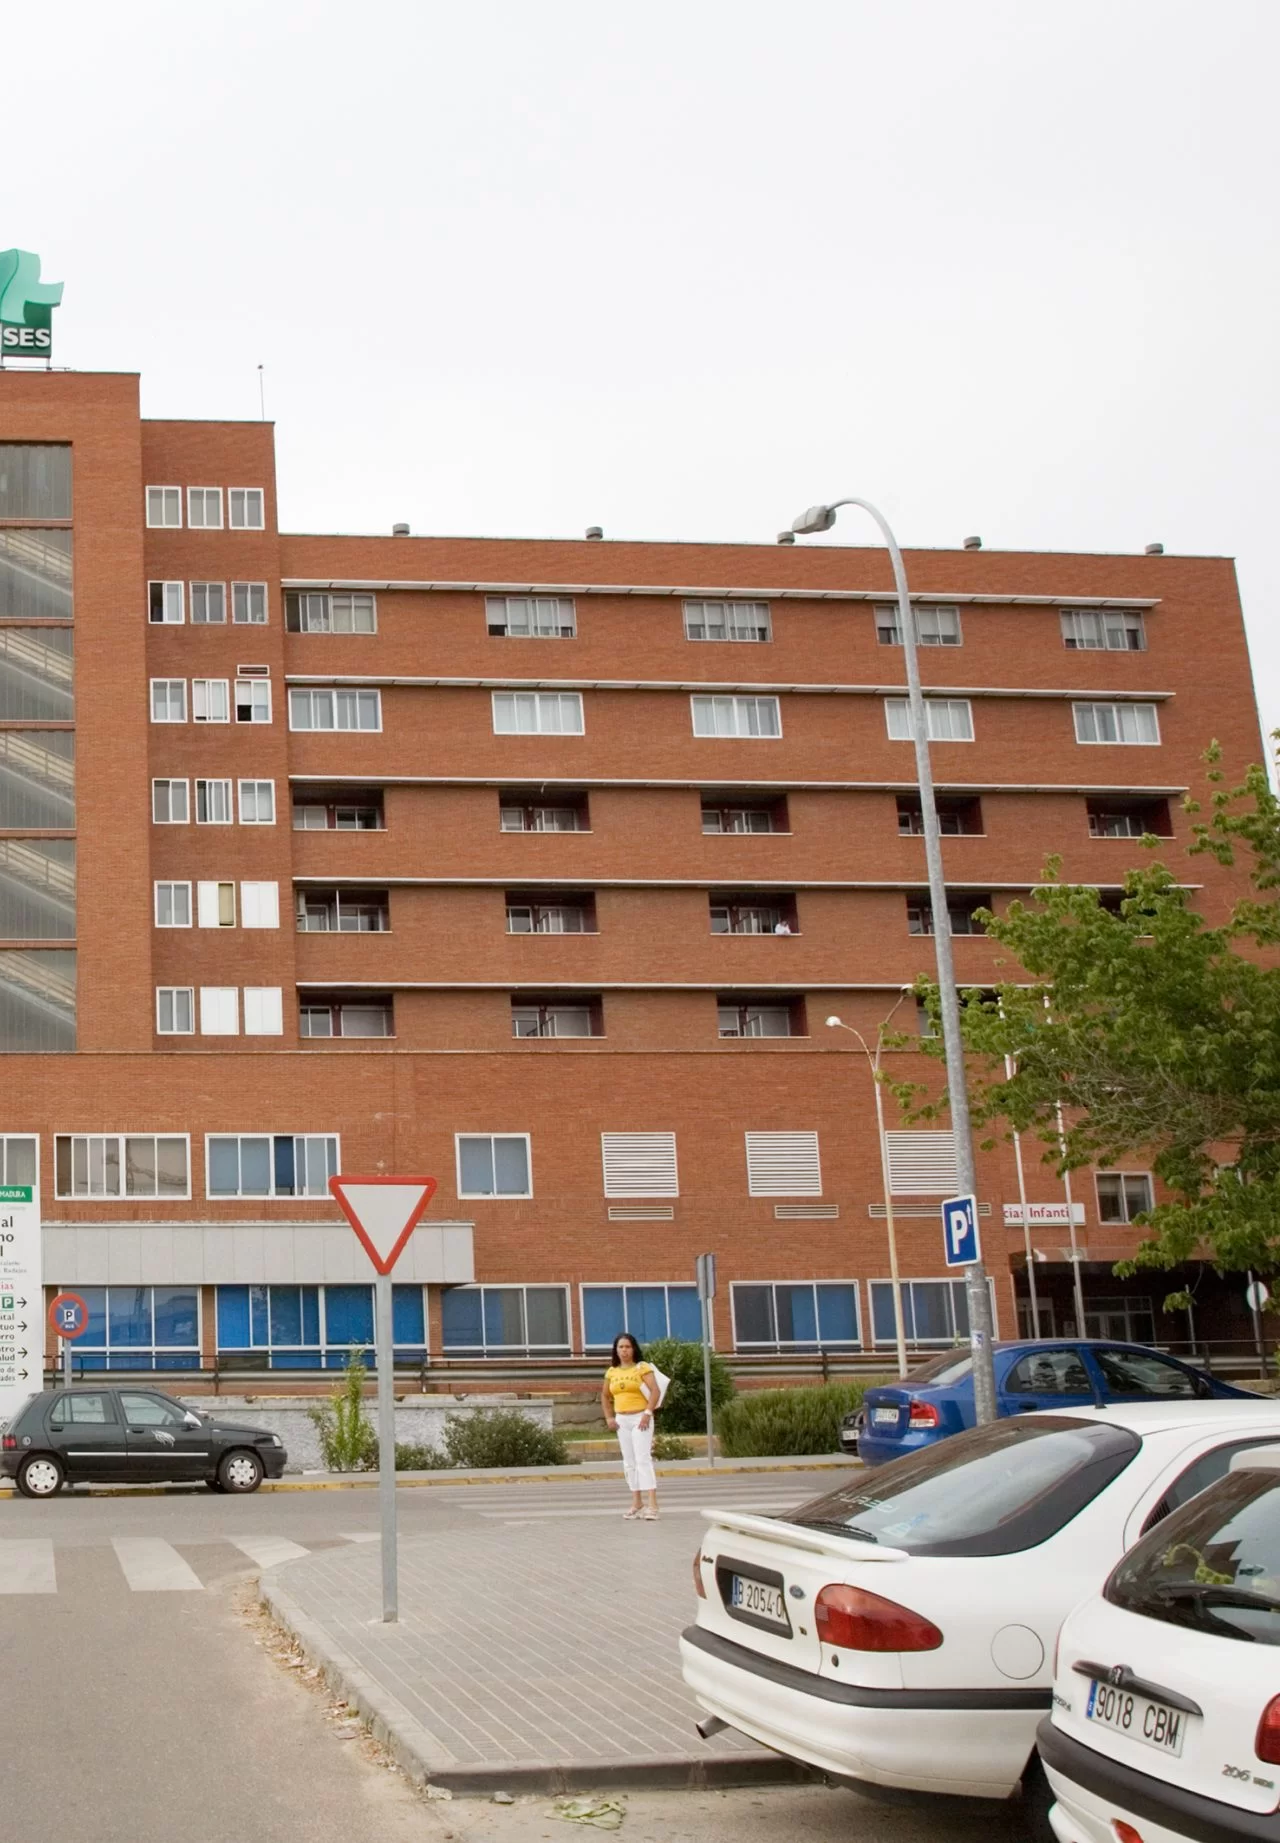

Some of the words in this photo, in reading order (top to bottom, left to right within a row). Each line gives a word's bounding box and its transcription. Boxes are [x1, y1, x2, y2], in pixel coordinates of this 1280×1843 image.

[3, 327, 50, 347] SES
[1029, 1206, 1070, 1218] Infanti
[950, 1210, 968, 1254] P
[4, 1298, 12, 1307] P
[66, 1311, 73, 1320] P
[1096, 1686, 1134, 1729] 9018
[1143, 1704, 1180, 1749] CBM
